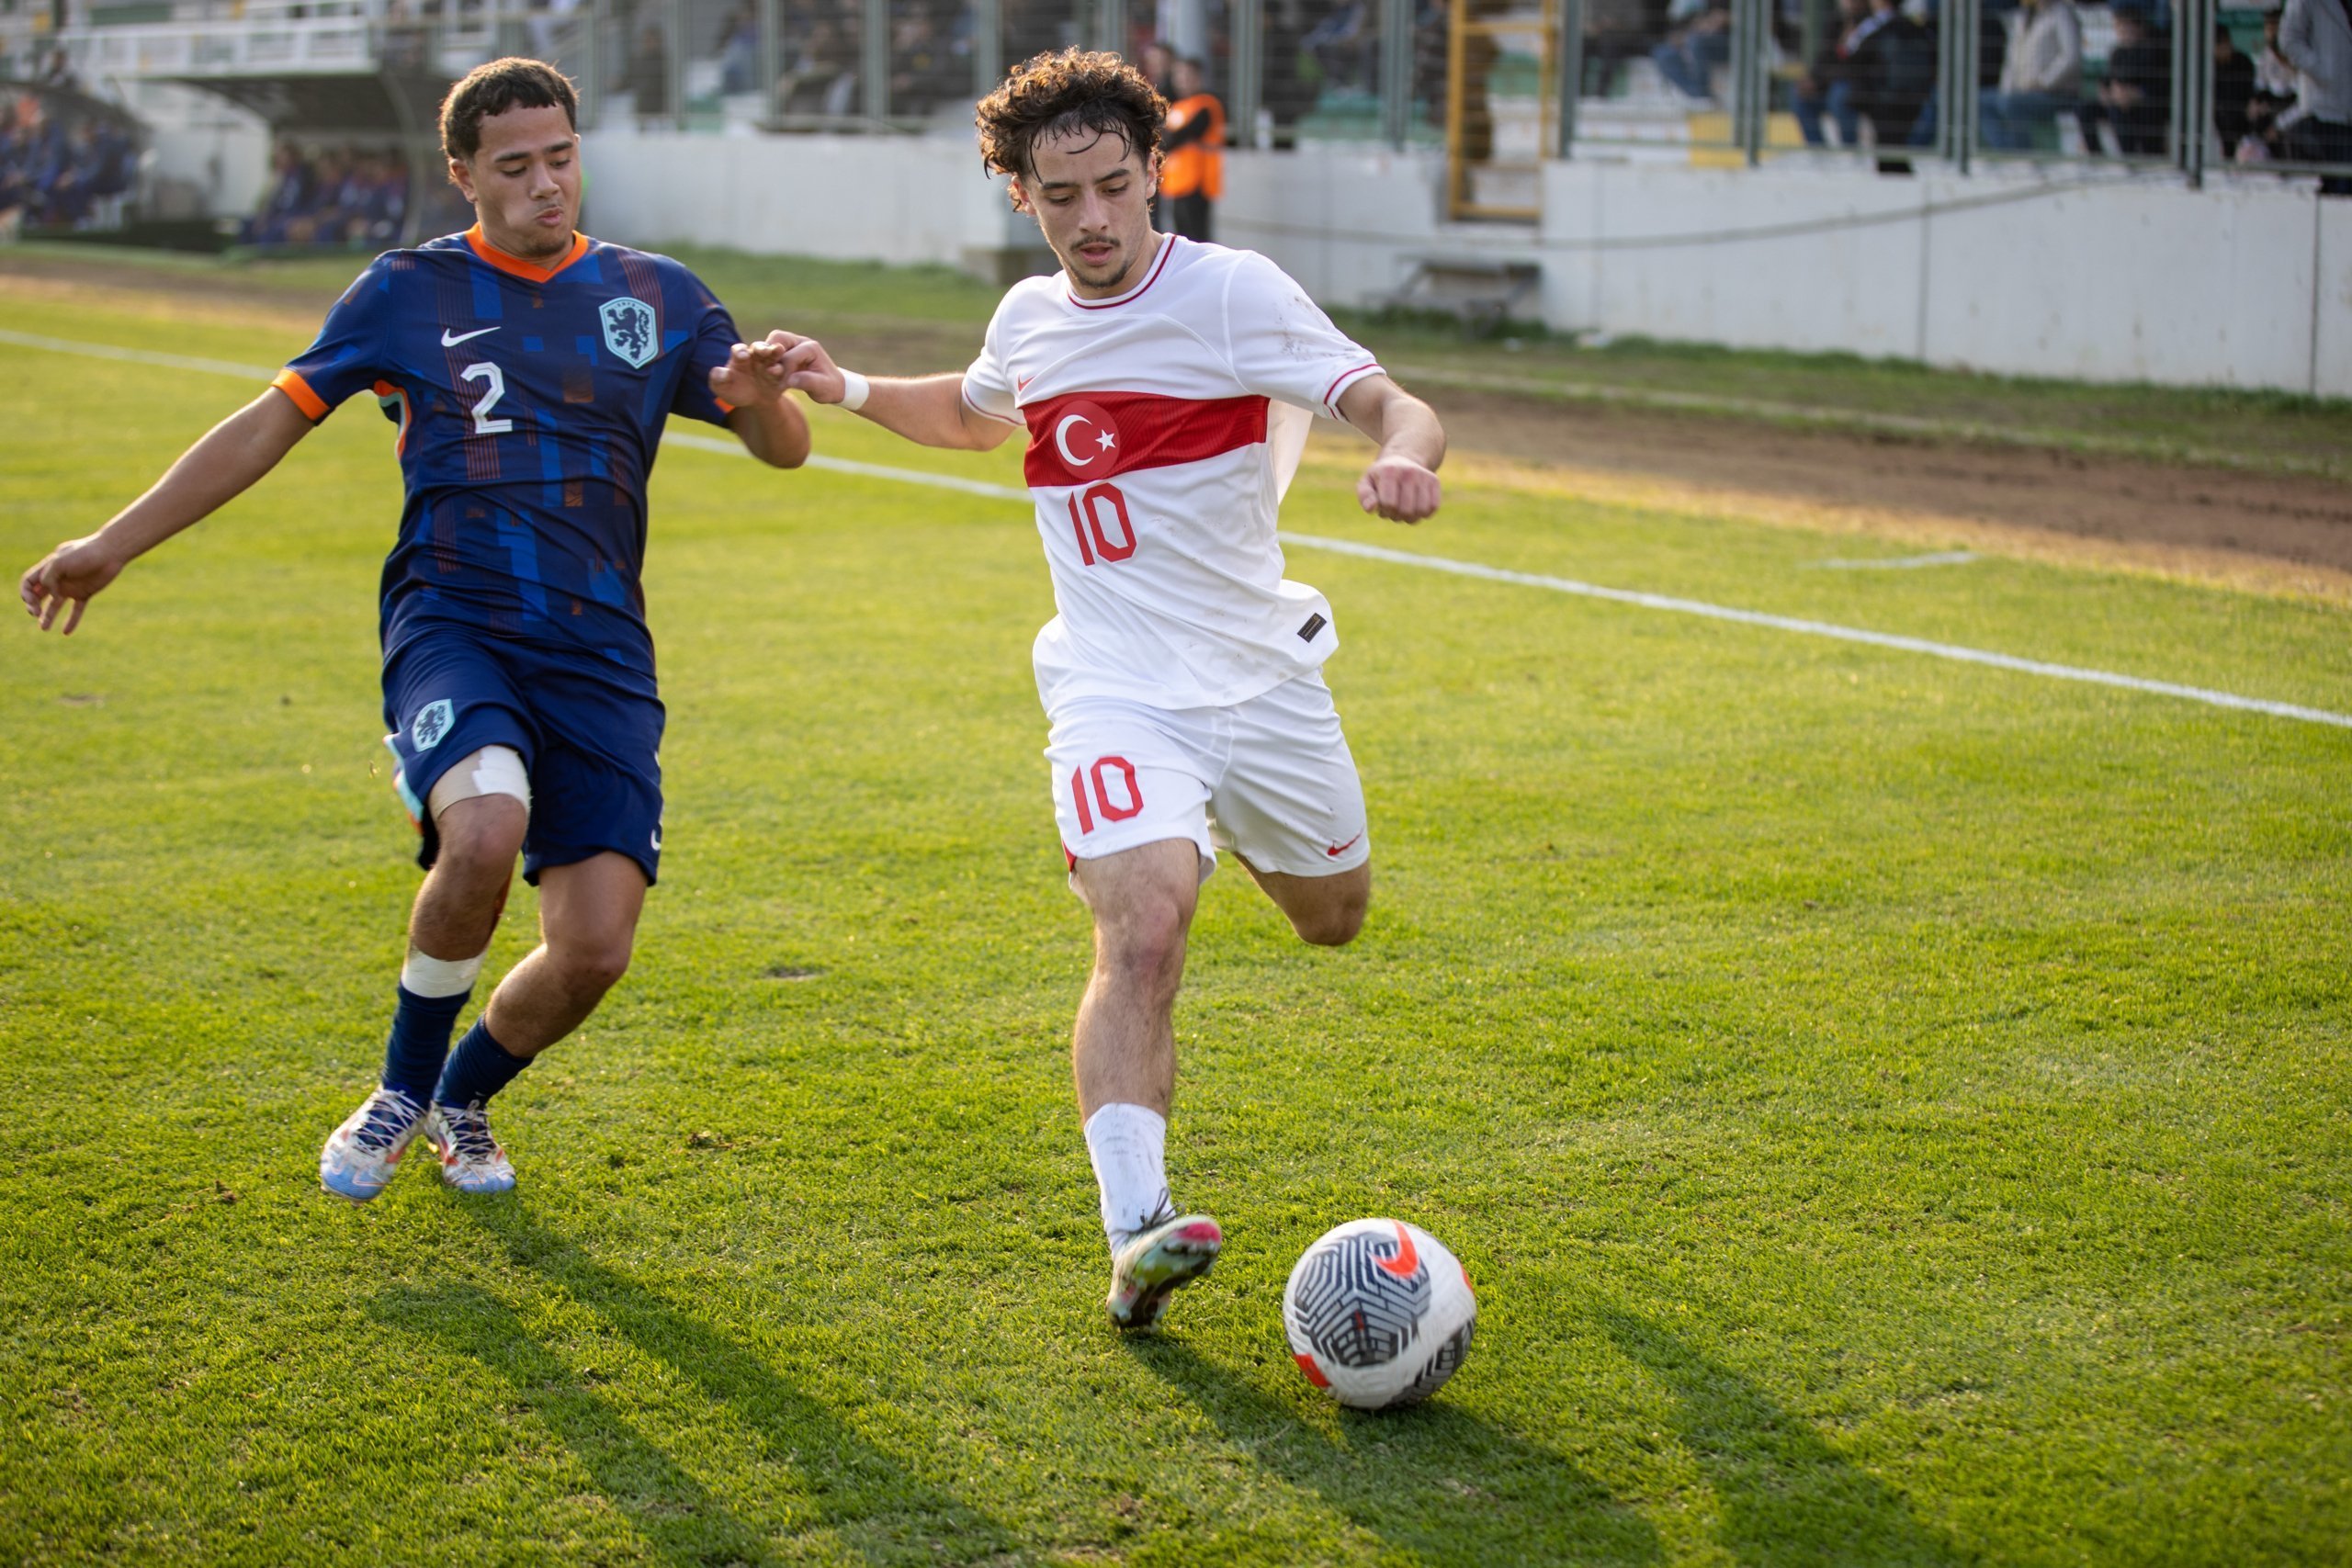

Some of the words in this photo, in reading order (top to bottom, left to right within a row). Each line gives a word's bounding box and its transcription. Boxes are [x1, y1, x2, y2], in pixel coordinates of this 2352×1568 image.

[460, 361, 513, 434] 2
[1068, 482, 1136, 566] 10
[1071, 755, 1144, 835] 10
